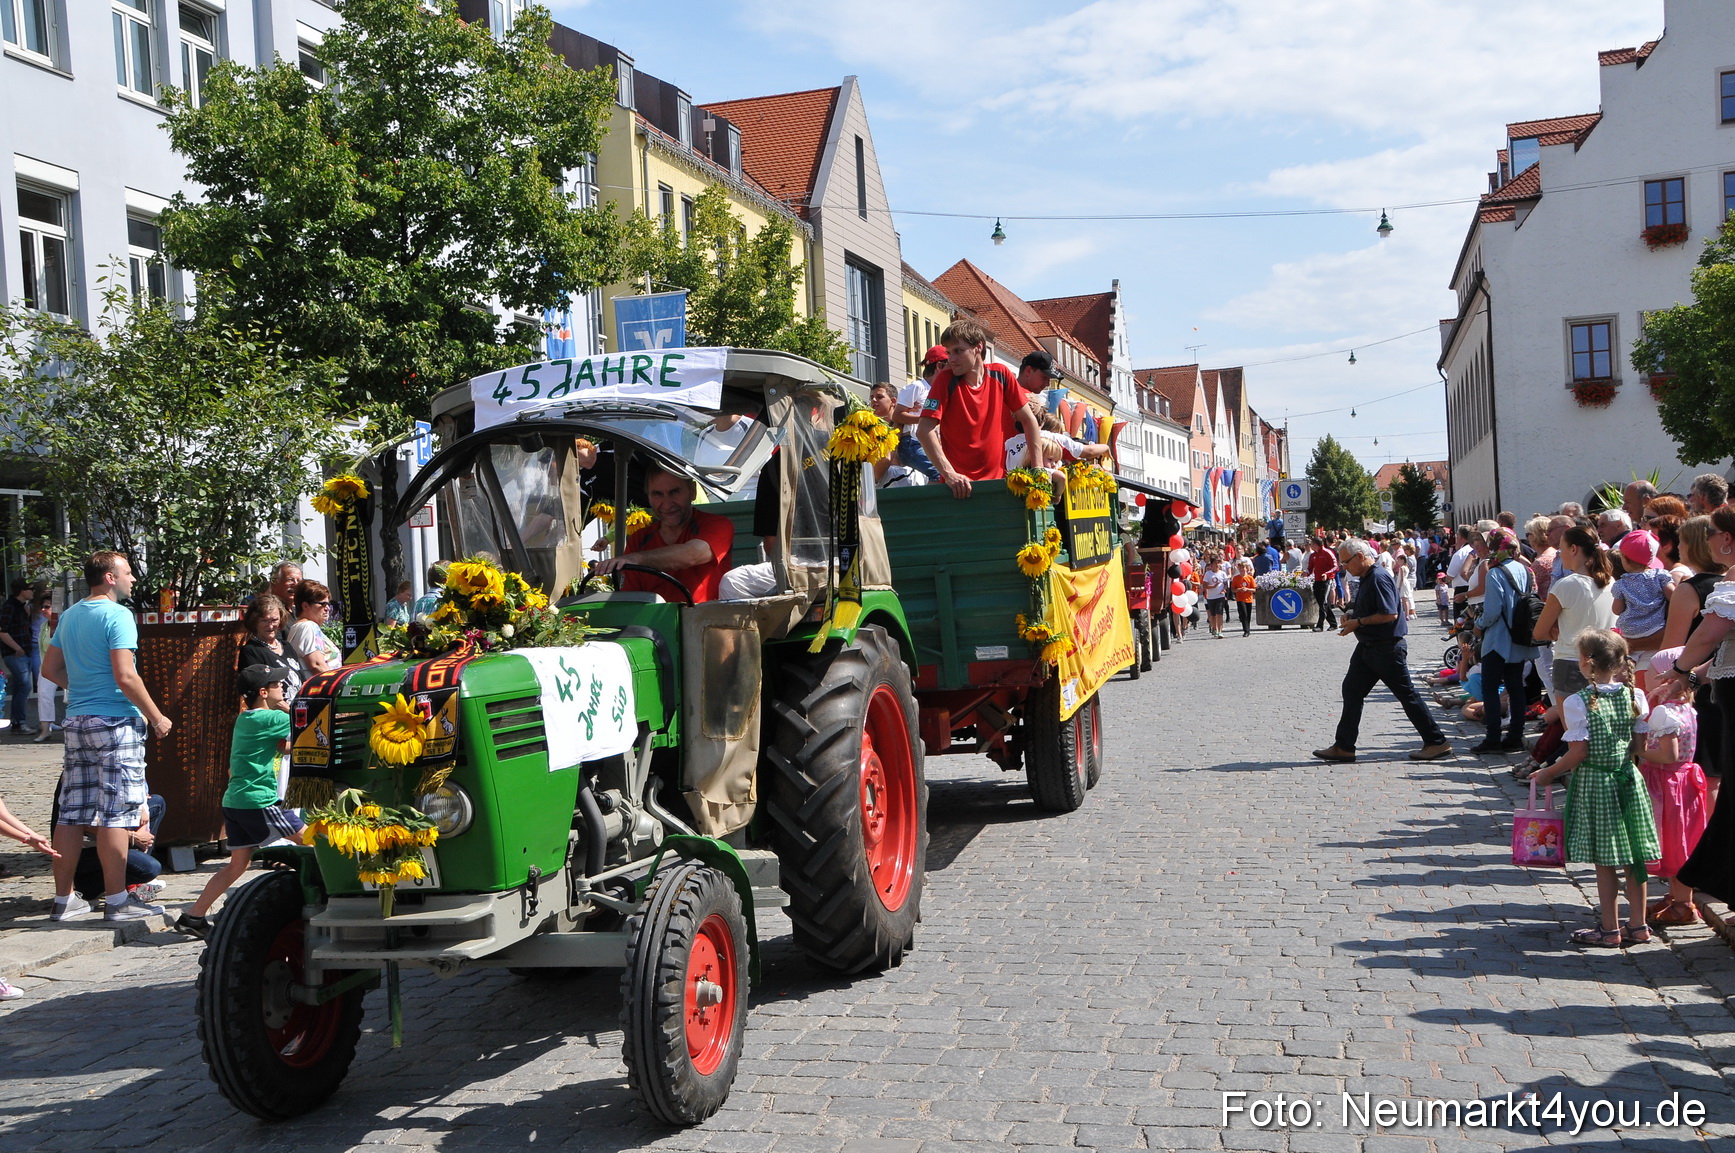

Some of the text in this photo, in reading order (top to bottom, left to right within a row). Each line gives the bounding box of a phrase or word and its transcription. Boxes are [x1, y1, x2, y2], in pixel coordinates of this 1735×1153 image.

[492, 354, 686, 407] 45 JAHRE
[1073, 525, 1095, 561] immer
[554, 655, 582, 703] 45
[577, 672, 603, 741] JAHRE
[611, 685, 627, 733] SÜD
